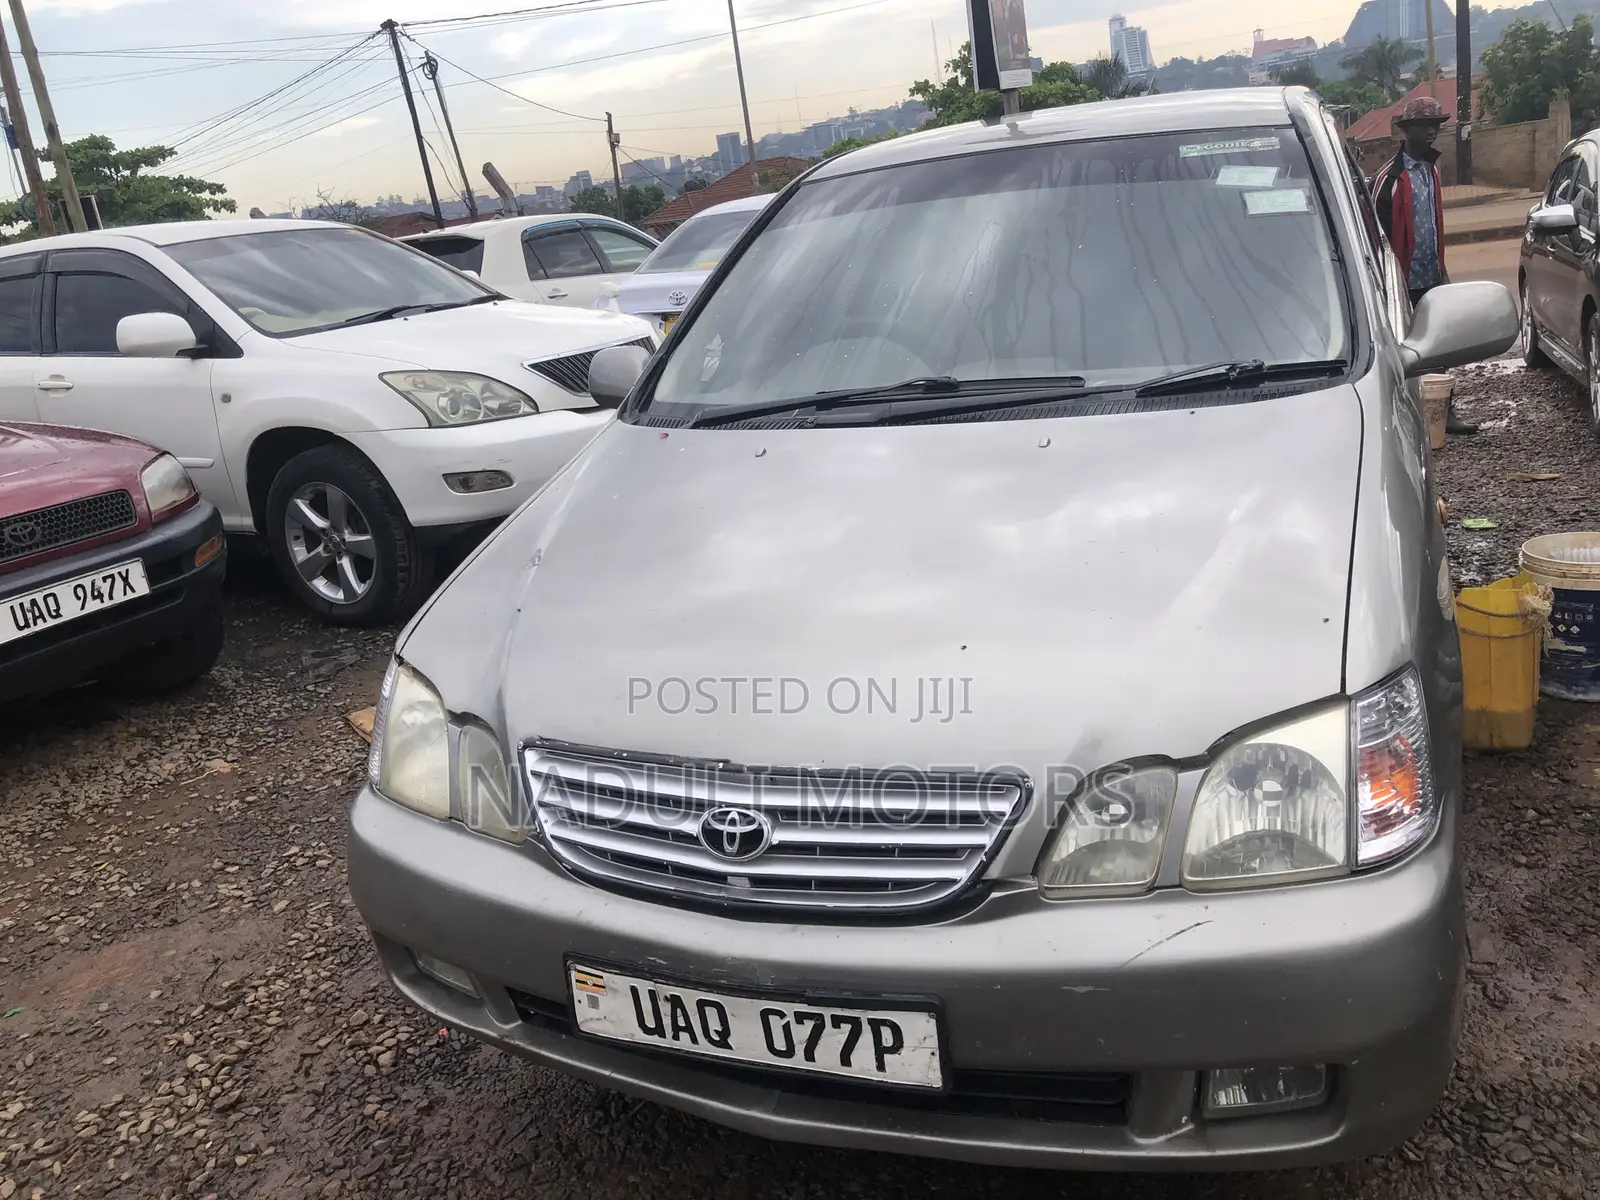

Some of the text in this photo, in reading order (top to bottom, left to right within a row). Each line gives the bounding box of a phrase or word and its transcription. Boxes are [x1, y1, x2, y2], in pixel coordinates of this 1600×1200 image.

[9, 568, 137, 632] UAQ 947X
[629, 985, 905, 1073] UAQ 077P
